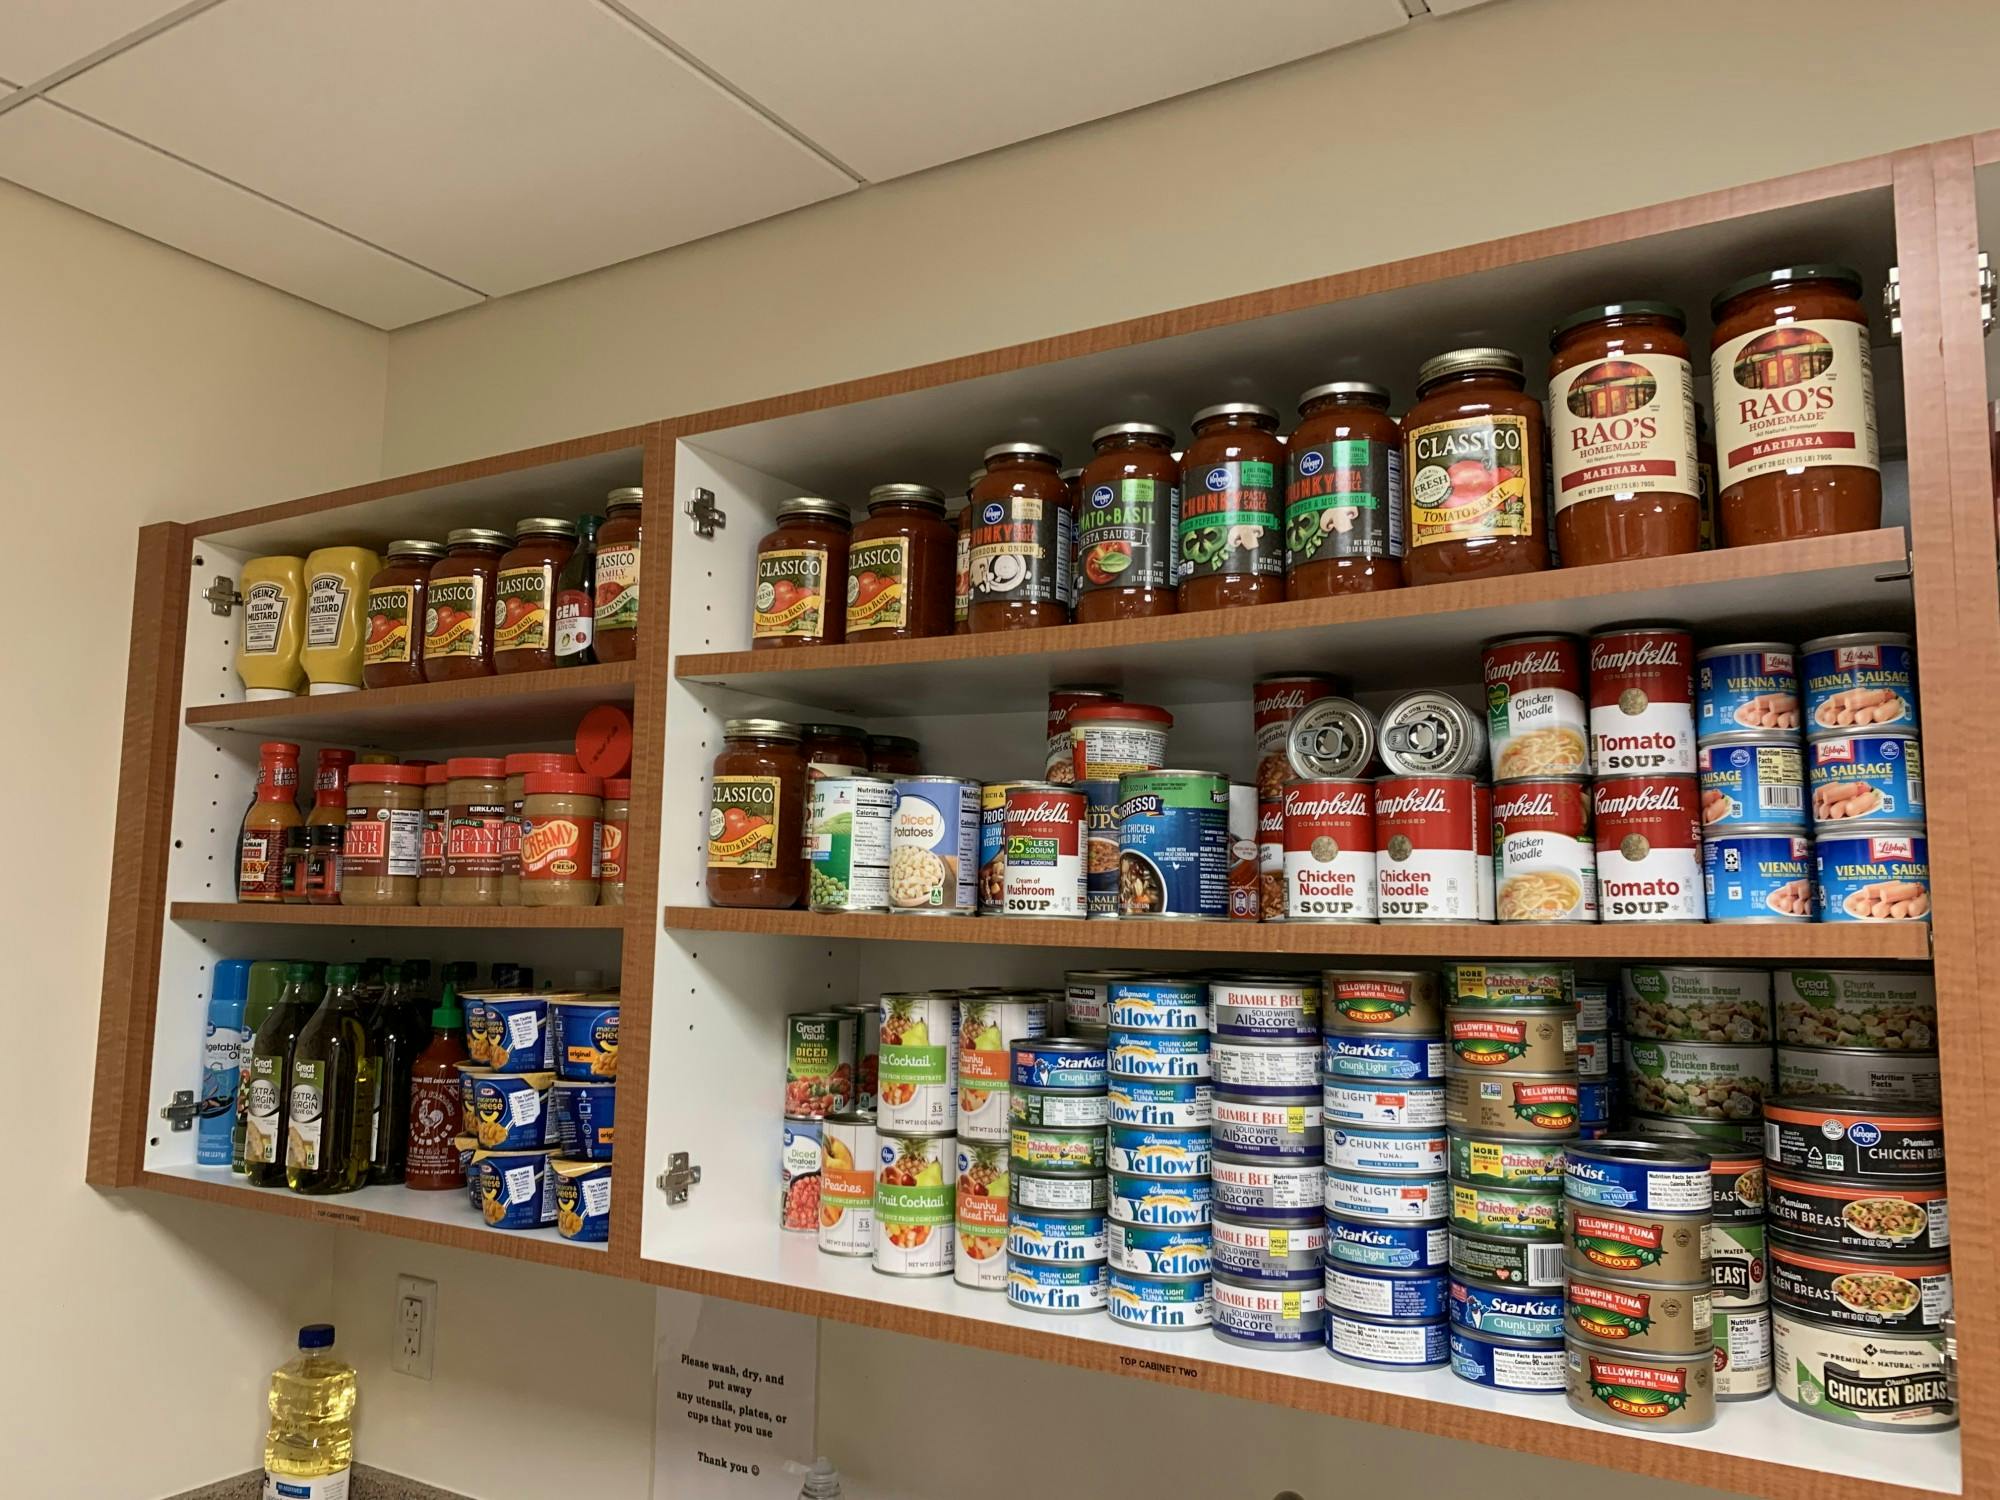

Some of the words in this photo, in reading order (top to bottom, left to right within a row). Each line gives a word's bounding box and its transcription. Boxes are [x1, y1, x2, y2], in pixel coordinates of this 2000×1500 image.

[1738, 385, 1834, 425] RAO'S
[1749, 411, 1825, 433] HOMEMADE
[1571, 416, 1657, 450] RAO'S
[1417, 429, 1520, 459] CLASSICO
[1580, 441, 1649, 458] HOMEMADE
[1752, 436, 1824, 455] MARINARA
[1583, 464, 1647, 481] MARINARA
[1414, 474, 1448, 496] FRESH
[1113, 508, 1155, 524] BASIL
[1102, 527, 1136, 540] SAUCE
[759, 560, 820, 577] CLASSICO
[312, 580, 336, 591] HEINZ
[497, 576, 545, 596] CLASSICO
[252, 588, 276, 600] HEINZ
[313, 594, 335, 605] YELLOW
[428, 586, 476, 604] CLASSICO
[251, 603, 274, 612] YELLOW
[310, 603, 340, 615] MUSTARD
[556, 603, 580, 620] GEM
[247, 611, 279, 622] MUSTARD
[1591, 640, 1679, 673] Campbell's
[1484, 650, 1562, 683] Campbell's
[1727, 677, 1775, 689] VIENNA
[1808, 674, 1852, 689] VIENNA
[1515, 693, 1554, 710] Chicken
[1517, 704, 1553, 722] Noodle
[1599, 731, 1676, 752] Tomato
[1608, 754, 1666, 769] SOUP
[1830, 762, 1893, 777] SAUSAGE
[713, 786, 773, 804] CLASSICO
[1594, 785, 1681, 817] Campbell's
[469, 805, 505, 814] KIRKLAND
[1285, 790, 1367, 820] Campbell's
[900, 814, 935, 825] Diced
[1004, 800, 1074, 827] Campbell's
[894, 826, 934, 839] Potatoes
[521, 827, 573, 858] CREAMY
[1508, 837, 1544, 852] Chicken
[1879, 841, 1907, 855] Libby's
[1509, 848, 1543, 864] Noodle
[552, 863, 576, 871] FRESH
[1835, 865, 1887, 877] VIENNA
[1297, 869, 1356, 883] Chicken
[1379, 869, 1431, 882] Chicken
[1007, 884, 1055, 897] Mushroom
[1299, 883, 1354, 897] Noodle
[1381, 883, 1429, 897] Noodle
[1603, 878, 1680, 897] Tomato
[1008, 899, 1051, 911] SOUP
[1300, 901, 1354, 914] SOUP
[1382, 902, 1429, 914] SOUP
[1612, 901, 1670, 915] SOUP
[1672, 985, 1710, 995] Chicken
[1712, 986, 1741, 995] Breast
[1843, 990, 1882, 999] Chicken
[1884, 990, 1917, 1000] Breast
[1234, 1012, 1296, 1028] Albacore
[1251, 1010, 1273, 1018] SOLID
[1273, 1010, 1295, 1018] WHITE
[796, 1022, 825, 1034] Great
[1453, 1023, 1494, 1032] YELLOWFIN
[1495, 1025, 1519, 1035] TUNA
[1119, 1034, 1152, 1048] Wegmans
[1158, 1040, 1181, 1048] CHUNK
[1182, 1040, 1199, 1048] LIGHT
[569, 1051, 592, 1060] original
[795, 1047, 828, 1057] DICED
[1338, 1041, 1396, 1058] StarKist
[1463, 1051, 1505, 1062] GENOVA
[254, 1056, 273, 1068] Great
[888, 1054, 931, 1068] Cocktail
[970, 1062, 993, 1076] Fruit
[1670, 1060, 1708, 1071] Chicken
[1709, 1061, 1740, 1072] Breast
[1870, 1074, 1905, 1082] Nutrition
[292, 1091, 318, 1102] EXTRA
[1521, 1088, 1564, 1097] YELLOWFIN
[291, 1100, 318, 1111] VIRGIN
[931, 1104, 943, 1113] 3.5
[1217, 1106, 1259, 1124] BUMBLE
[1262, 1111, 1285, 1125] BEE
[1221, 1128, 1279, 1145] Albacore
[1235, 1126, 1255, 1135] SOLID
[1255, 1127, 1278, 1136] WHITE
[1349, 1139, 1389, 1150] CHUNK
[1394, 1141, 1427, 1151] LIGHT
[1500, 1154, 1545, 1169] Chicken
[1869, 1148, 1925, 1161] CHICKEN
[825, 1178, 861, 1194] Peaches
[1148, 1183, 1187, 1197] Wegmans
[1329, 1179, 1359, 1194] CHUNK
[1363, 1184, 1398, 1198] LIGHT
[877, 1191, 898, 1207] Fruit
[898, 1192, 945, 1209] Cocktail
[964, 1197, 998, 1213] Chunky
[1216, 1188, 1264, 1206] Albacore
[1779, 1195, 1811, 1211] Premium
[1044, 1223, 1067, 1232] CHUNK
[1067, 1224, 1085, 1232] LIGHT
[1800, 1211, 1849, 1229] BREAST
[1336, 1226, 1393, 1247] StarKist
[1577, 1217, 1626, 1233] YELLOWFIN
[1627, 1226, 1655, 1241] TUNA
[1243, 1232, 1267, 1247] BEE
[1215, 1248, 1260, 1268] Albacore
[1338, 1245, 1362, 1258] Chunk
[1363, 1247, 1386, 1262] Light
[1589, 1250, 1638, 1268] GENOVA
[1776, 1265, 1803, 1282] Premium
[1215, 1286, 1255, 1308] BUMBLE
[1256, 1295, 1280, 1311] BEE
[1570, 1284, 1613, 1303] YELLOWFIN
[1614, 1294, 1642, 1310] TUNA
[1793, 1283, 1839, 1302] BREAST
[1490, 1297, 1557, 1316] StarKist
[1219, 1312, 1273, 1332] Albacore
[1493, 1318, 1526, 1330] Chunk
[1527, 1319, 1551, 1333] Light
[1580, 1319, 1625, 1337] GENOVA
[1730, 1318, 1757, 1327] Nutrition
[681, 1353, 710, 1371] Please
[712, 1364, 740, 1378] wash,
[742, 1367, 763, 1383] dry,
[765, 1374, 785, 1386] and
[1119, 1355, 1138, 1367] TOP
[1138, 1359, 1177, 1375] CABINET
[1177, 1366, 1198, 1378] TWO
[1596, 1364, 1652, 1380] YELLOWFIN
[1653, 1371, 1680, 1385] TUNA
[708, 1378, 725, 1391] put
[727, 1382, 753, 1399] away
[1827, 1378, 1900, 1408] CHICKEN
[676, 1390, 694, 1405] any
[695, 1393, 737, 1415] utensils,
[739, 1403, 773, 1424] plates,
[775, 1413, 788, 1425] or
[1612, 1398, 1665, 1416] GENOVA
[687, 1410, 709, 1425] cups
[711, 1415, 732, 1429] that
[734, 1422, 754, 1435] you
[756, 1426, 774, 1439] use
[697, 1450, 728, 1469] Thank
[729, 1461, 749, 1476] you
